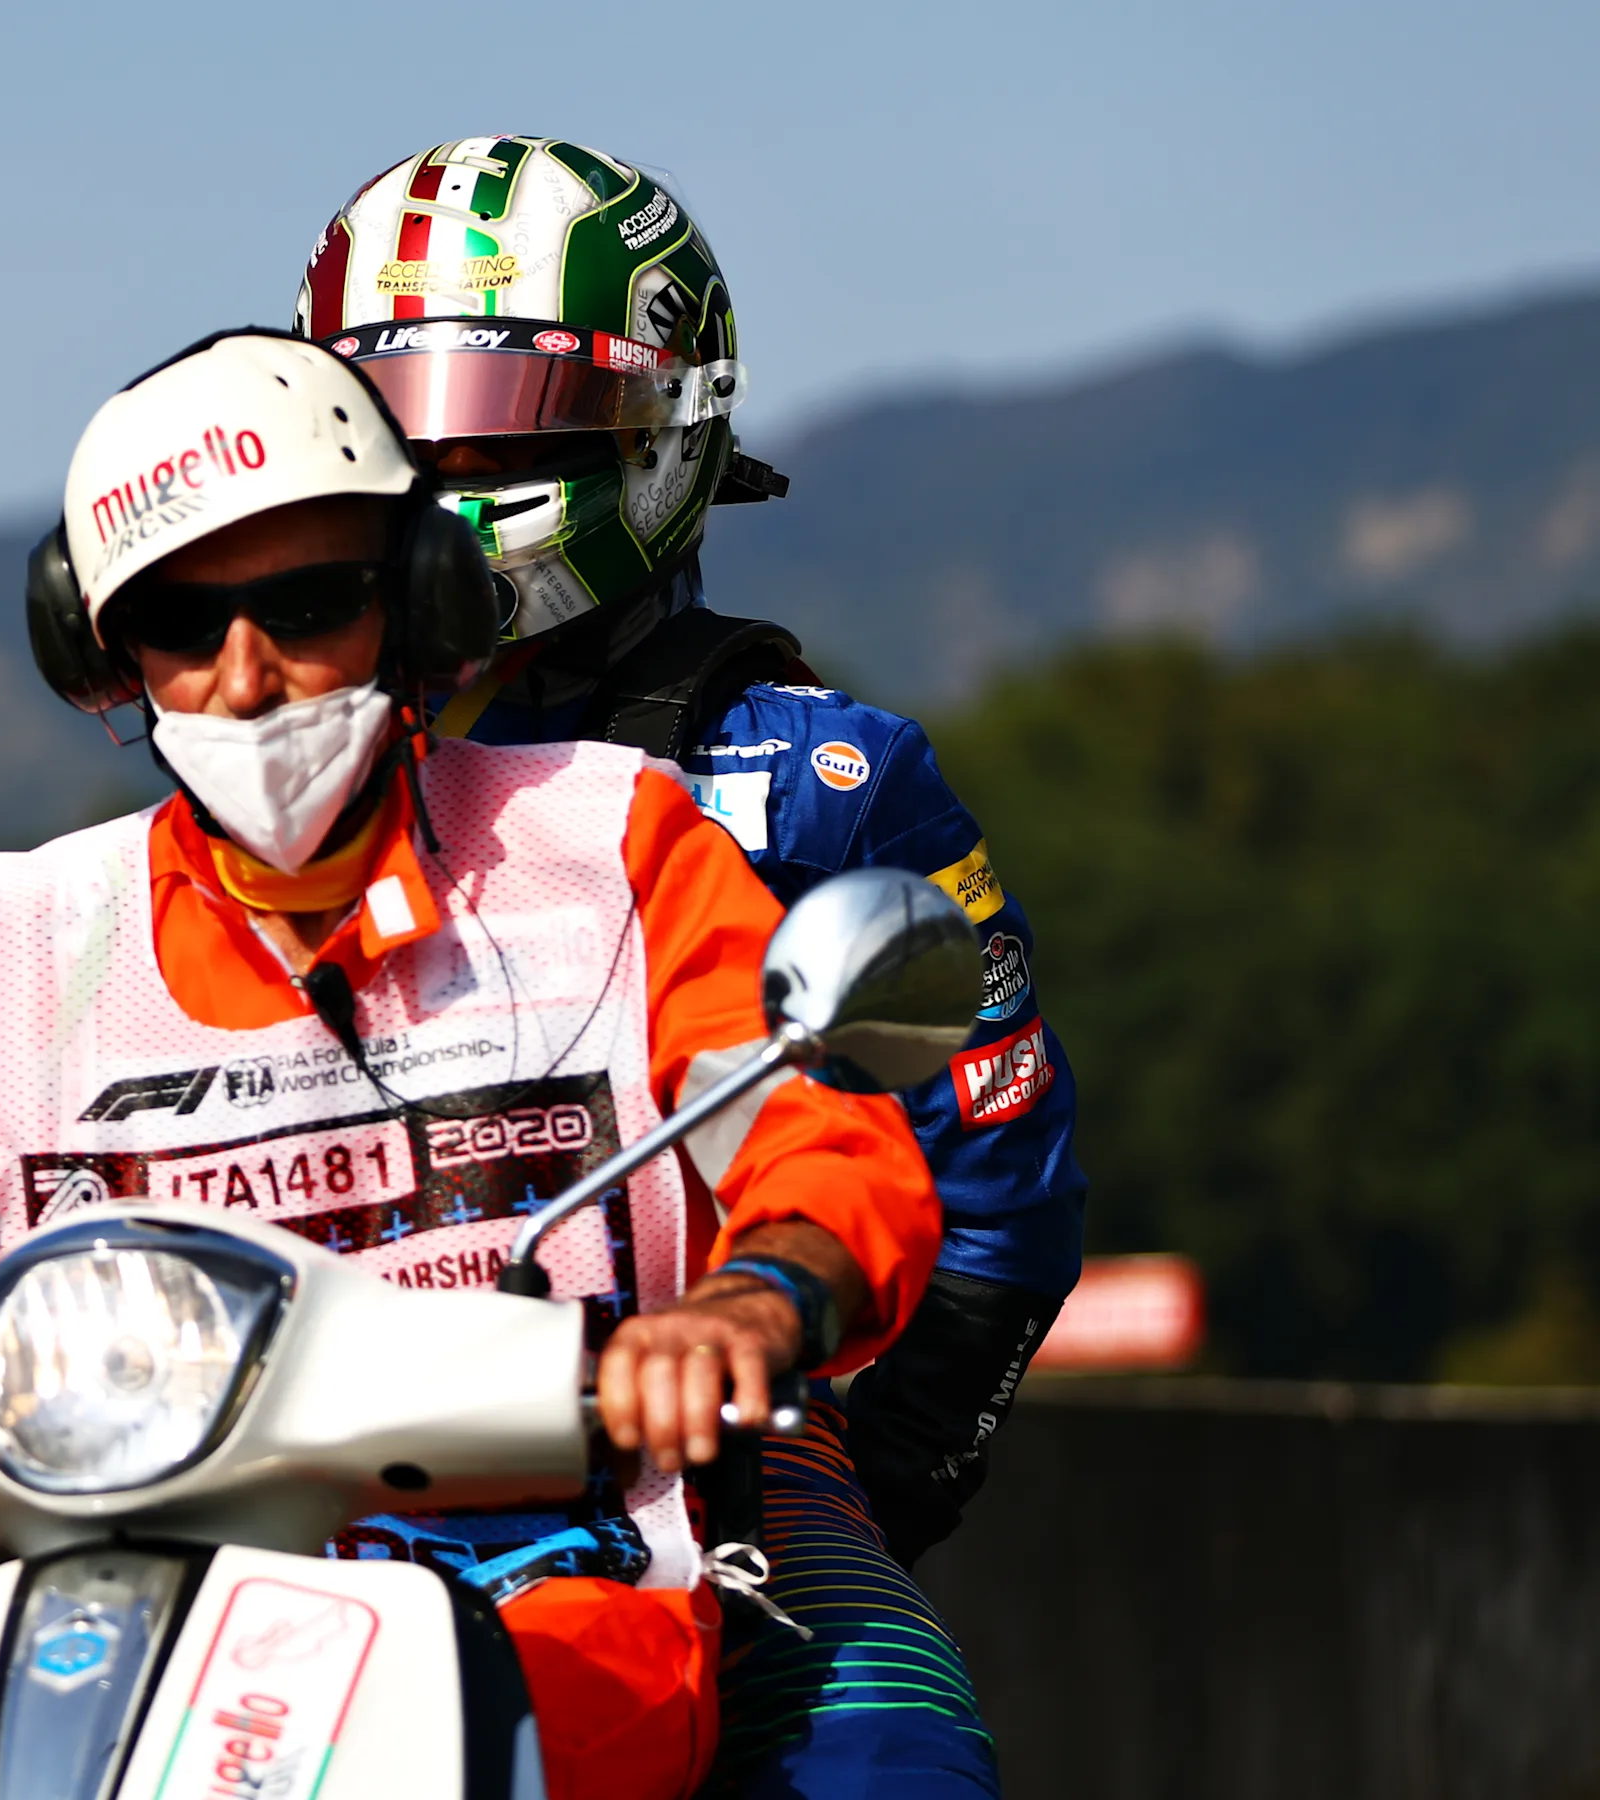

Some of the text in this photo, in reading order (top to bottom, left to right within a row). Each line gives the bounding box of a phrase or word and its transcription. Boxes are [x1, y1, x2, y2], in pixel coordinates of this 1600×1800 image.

[637, 288, 649, 342] UCINE
[374, 326, 510, 352] Lifeuoy
[608, 337, 658, 370] HUSKI
[92, 424, 266, 545] mugello
[631, 461, 688, 520] POGGIO
[636, 483, 684, 537] SECCO
[536, 586, 566, 623] PALAGIO
[815, 752, 866, 779] Gulf
[982, 950, 1020, 987] strella
[313, 1035, 398, 1064] Forula
[963, 1028, 1047, 1102] HUSK
[279, 1068, 338, 1093] World
[972, 1066, 1052, 1119] CHOCOLAT
[425, 1104, 593, 1170] 2020
